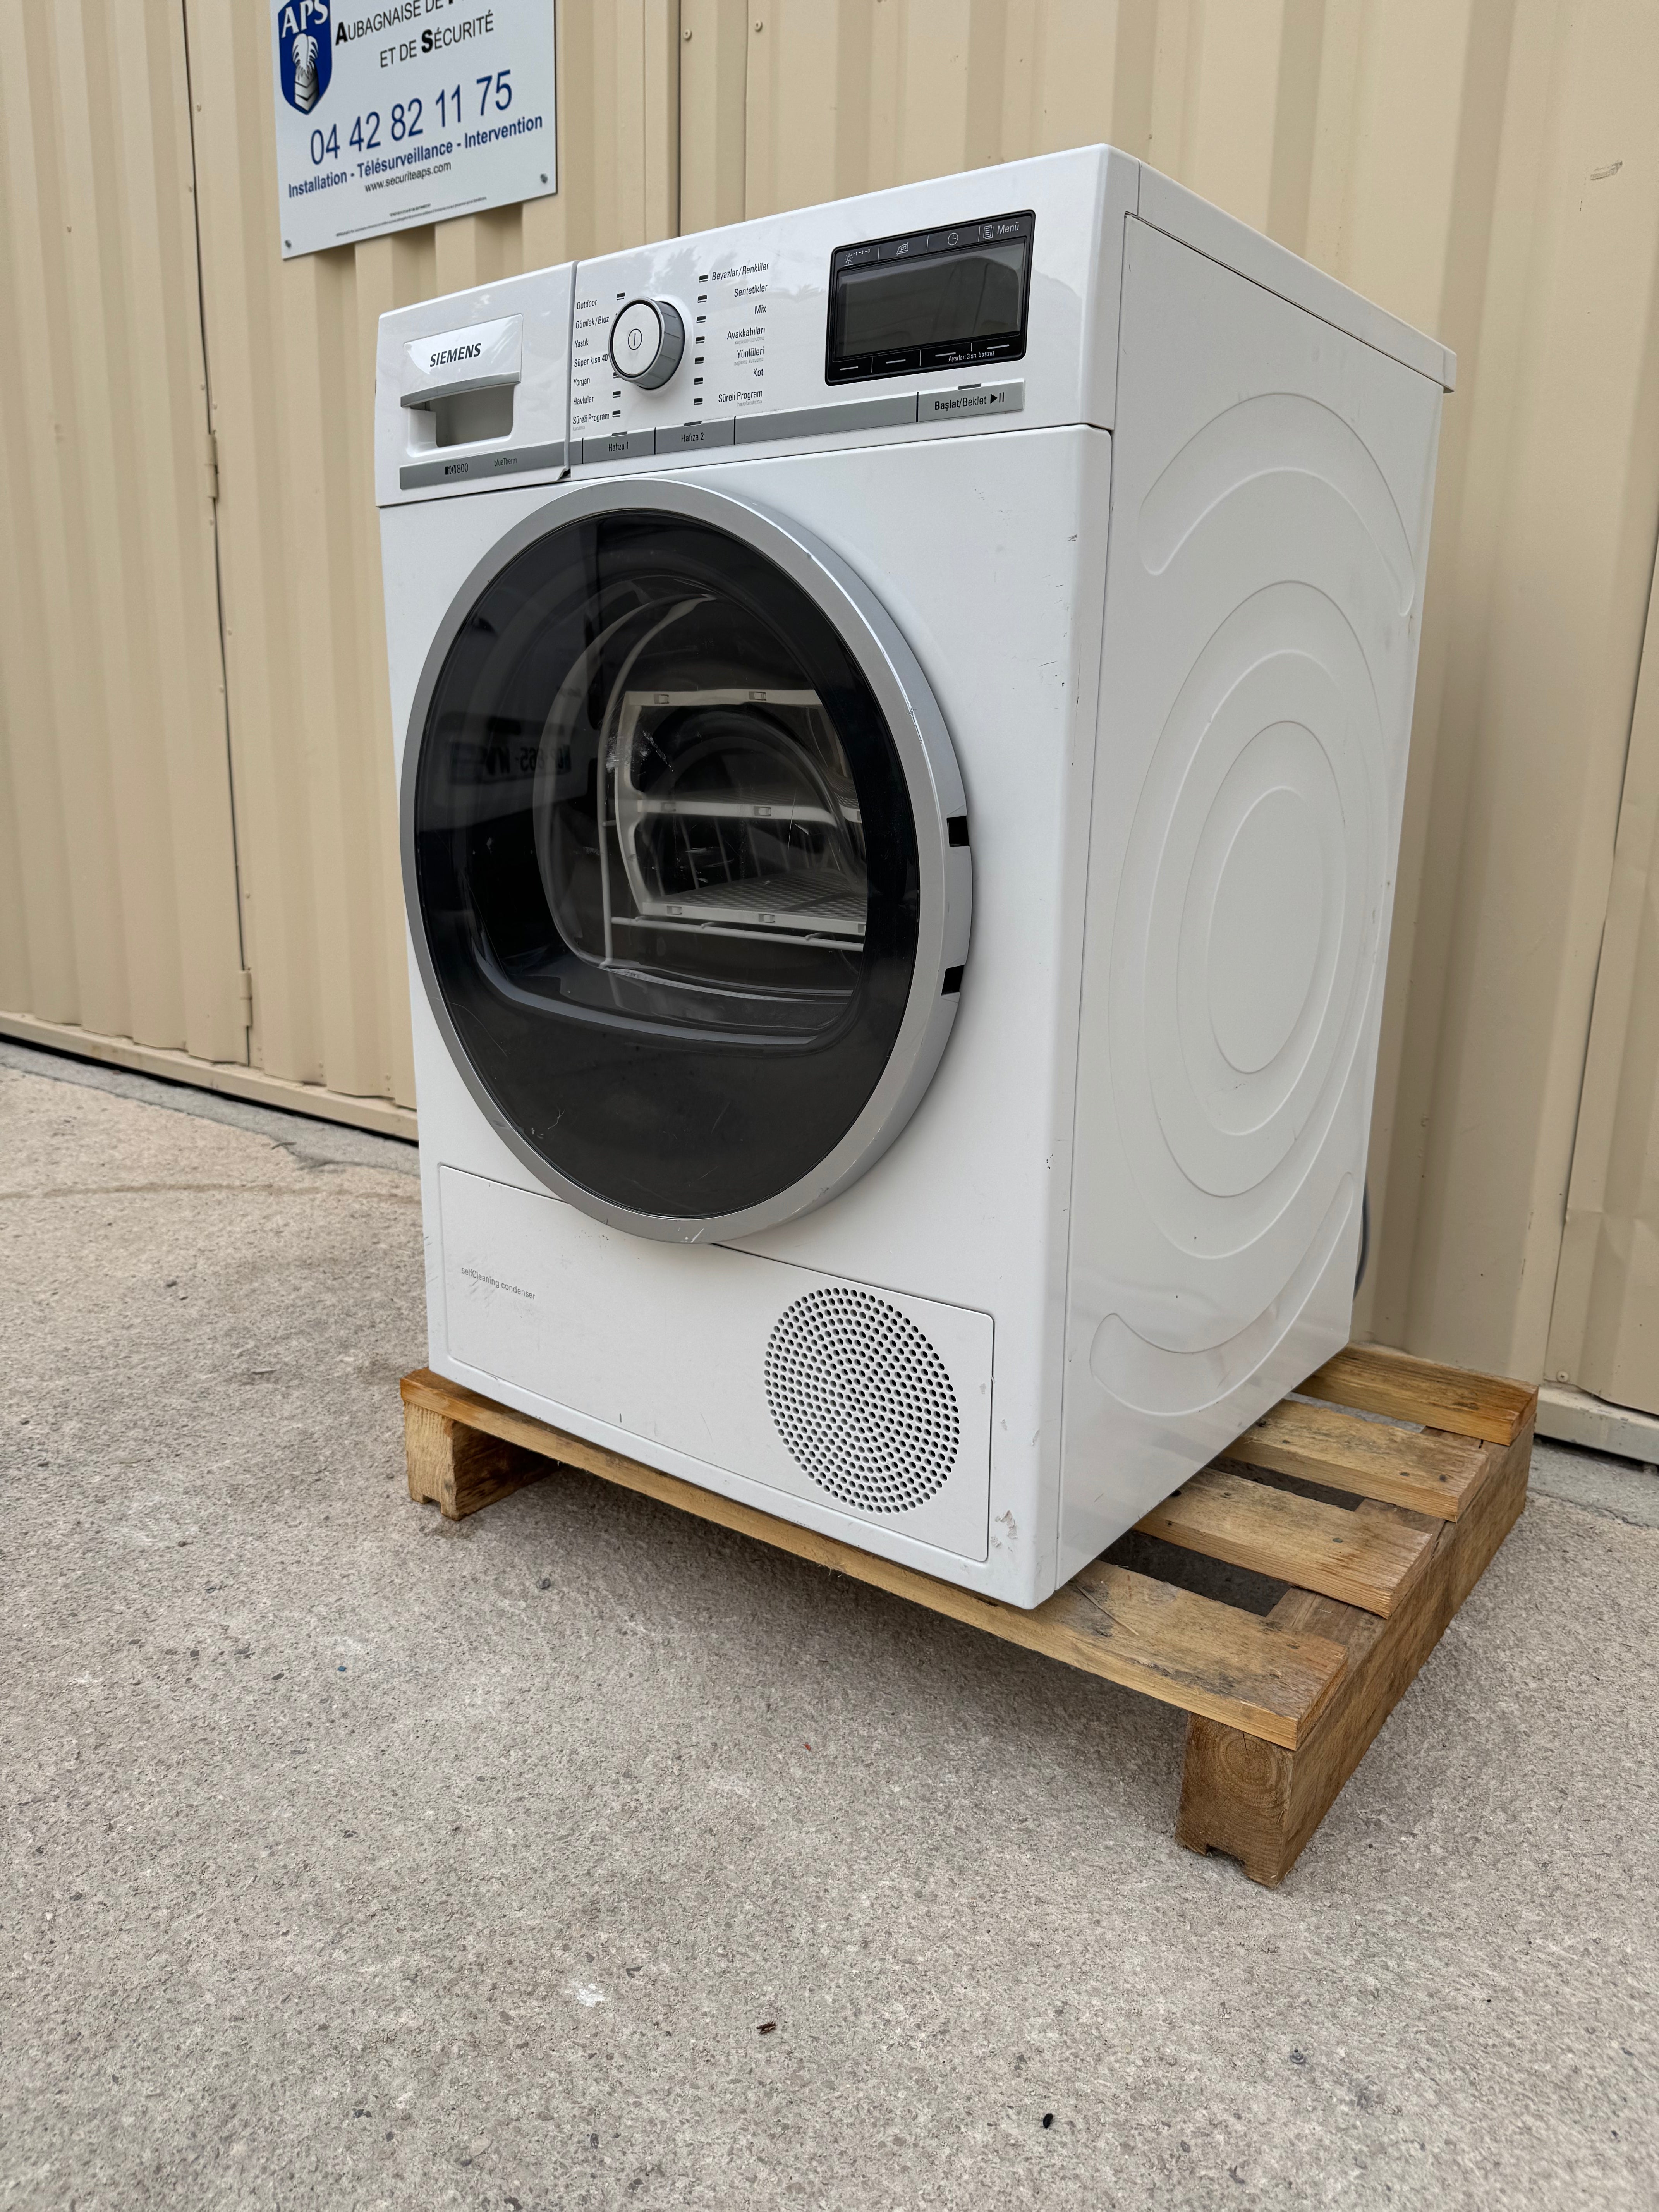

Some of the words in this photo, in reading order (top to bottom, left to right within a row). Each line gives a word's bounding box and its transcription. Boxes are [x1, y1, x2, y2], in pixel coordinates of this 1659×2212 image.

[282, 0, 328, 38] APS
[335, 0, 421, 46] AUBAGNAISE
[380, 46, 397, 68] ET
[400, 40, 417, 62] DE
[421, 10, 494, 53] SÉCURITÉ
[311, 124, 340, 165] 04
[349, 111, 381, 153] 42
[391, 98, 423, 141] 82
[436, 84, 462, 127] 11
[476, 70, 512, 116] 75
[289, 172, 347, 198] Installation
[357, 140, 453, 179] Télésurveillance
[465, 116, 543, 149] Intervention
[365, 161, 451, 193] www.securiteaps.com
[997, 222, 1019, 235] Menü
[712, 263, 769, 281] Beyazlar/Renkliler
[734, 284, 768, 297] Sentetikler
[577, 300, 597, 309] Outdoor
[755, 304, 766, 314] Mix
[576, 316, 609, 329] Gömlek/Bluz
[727, 326, 765, 340] Ayakkabıları
[575, 338, 589, 348] Yastık
[430, 343, 481, 368] SIEMENS
[737, 346, 764, 358] Yünlüleri
[948, 354, 966, 362] Ayarlar:
[574, 359, 589, 368] Süper
[753, 368, 763, 377] Kot
[574, 376, 590, 386] Yorgan
[573, 395, 594, 405] Havlular
[718, 392, 735, 402] Süreli
[737, 391, 763, 400] Program
[935, 396, 987, 411] Başlat/Beklet
[573, 415, 587, 424] Süreli
[588, 414, 609, 422] Program
[681, 434, 699, 442] Hafıza
[701, 432, 704, 440] 2
[608, 443, 624, 452] Hafıza
[494, 458, 517, 467] blueTherm
[462, 1267, 500, 1288] selfCleaning
[501, 1282, 536, 1300] condenser
